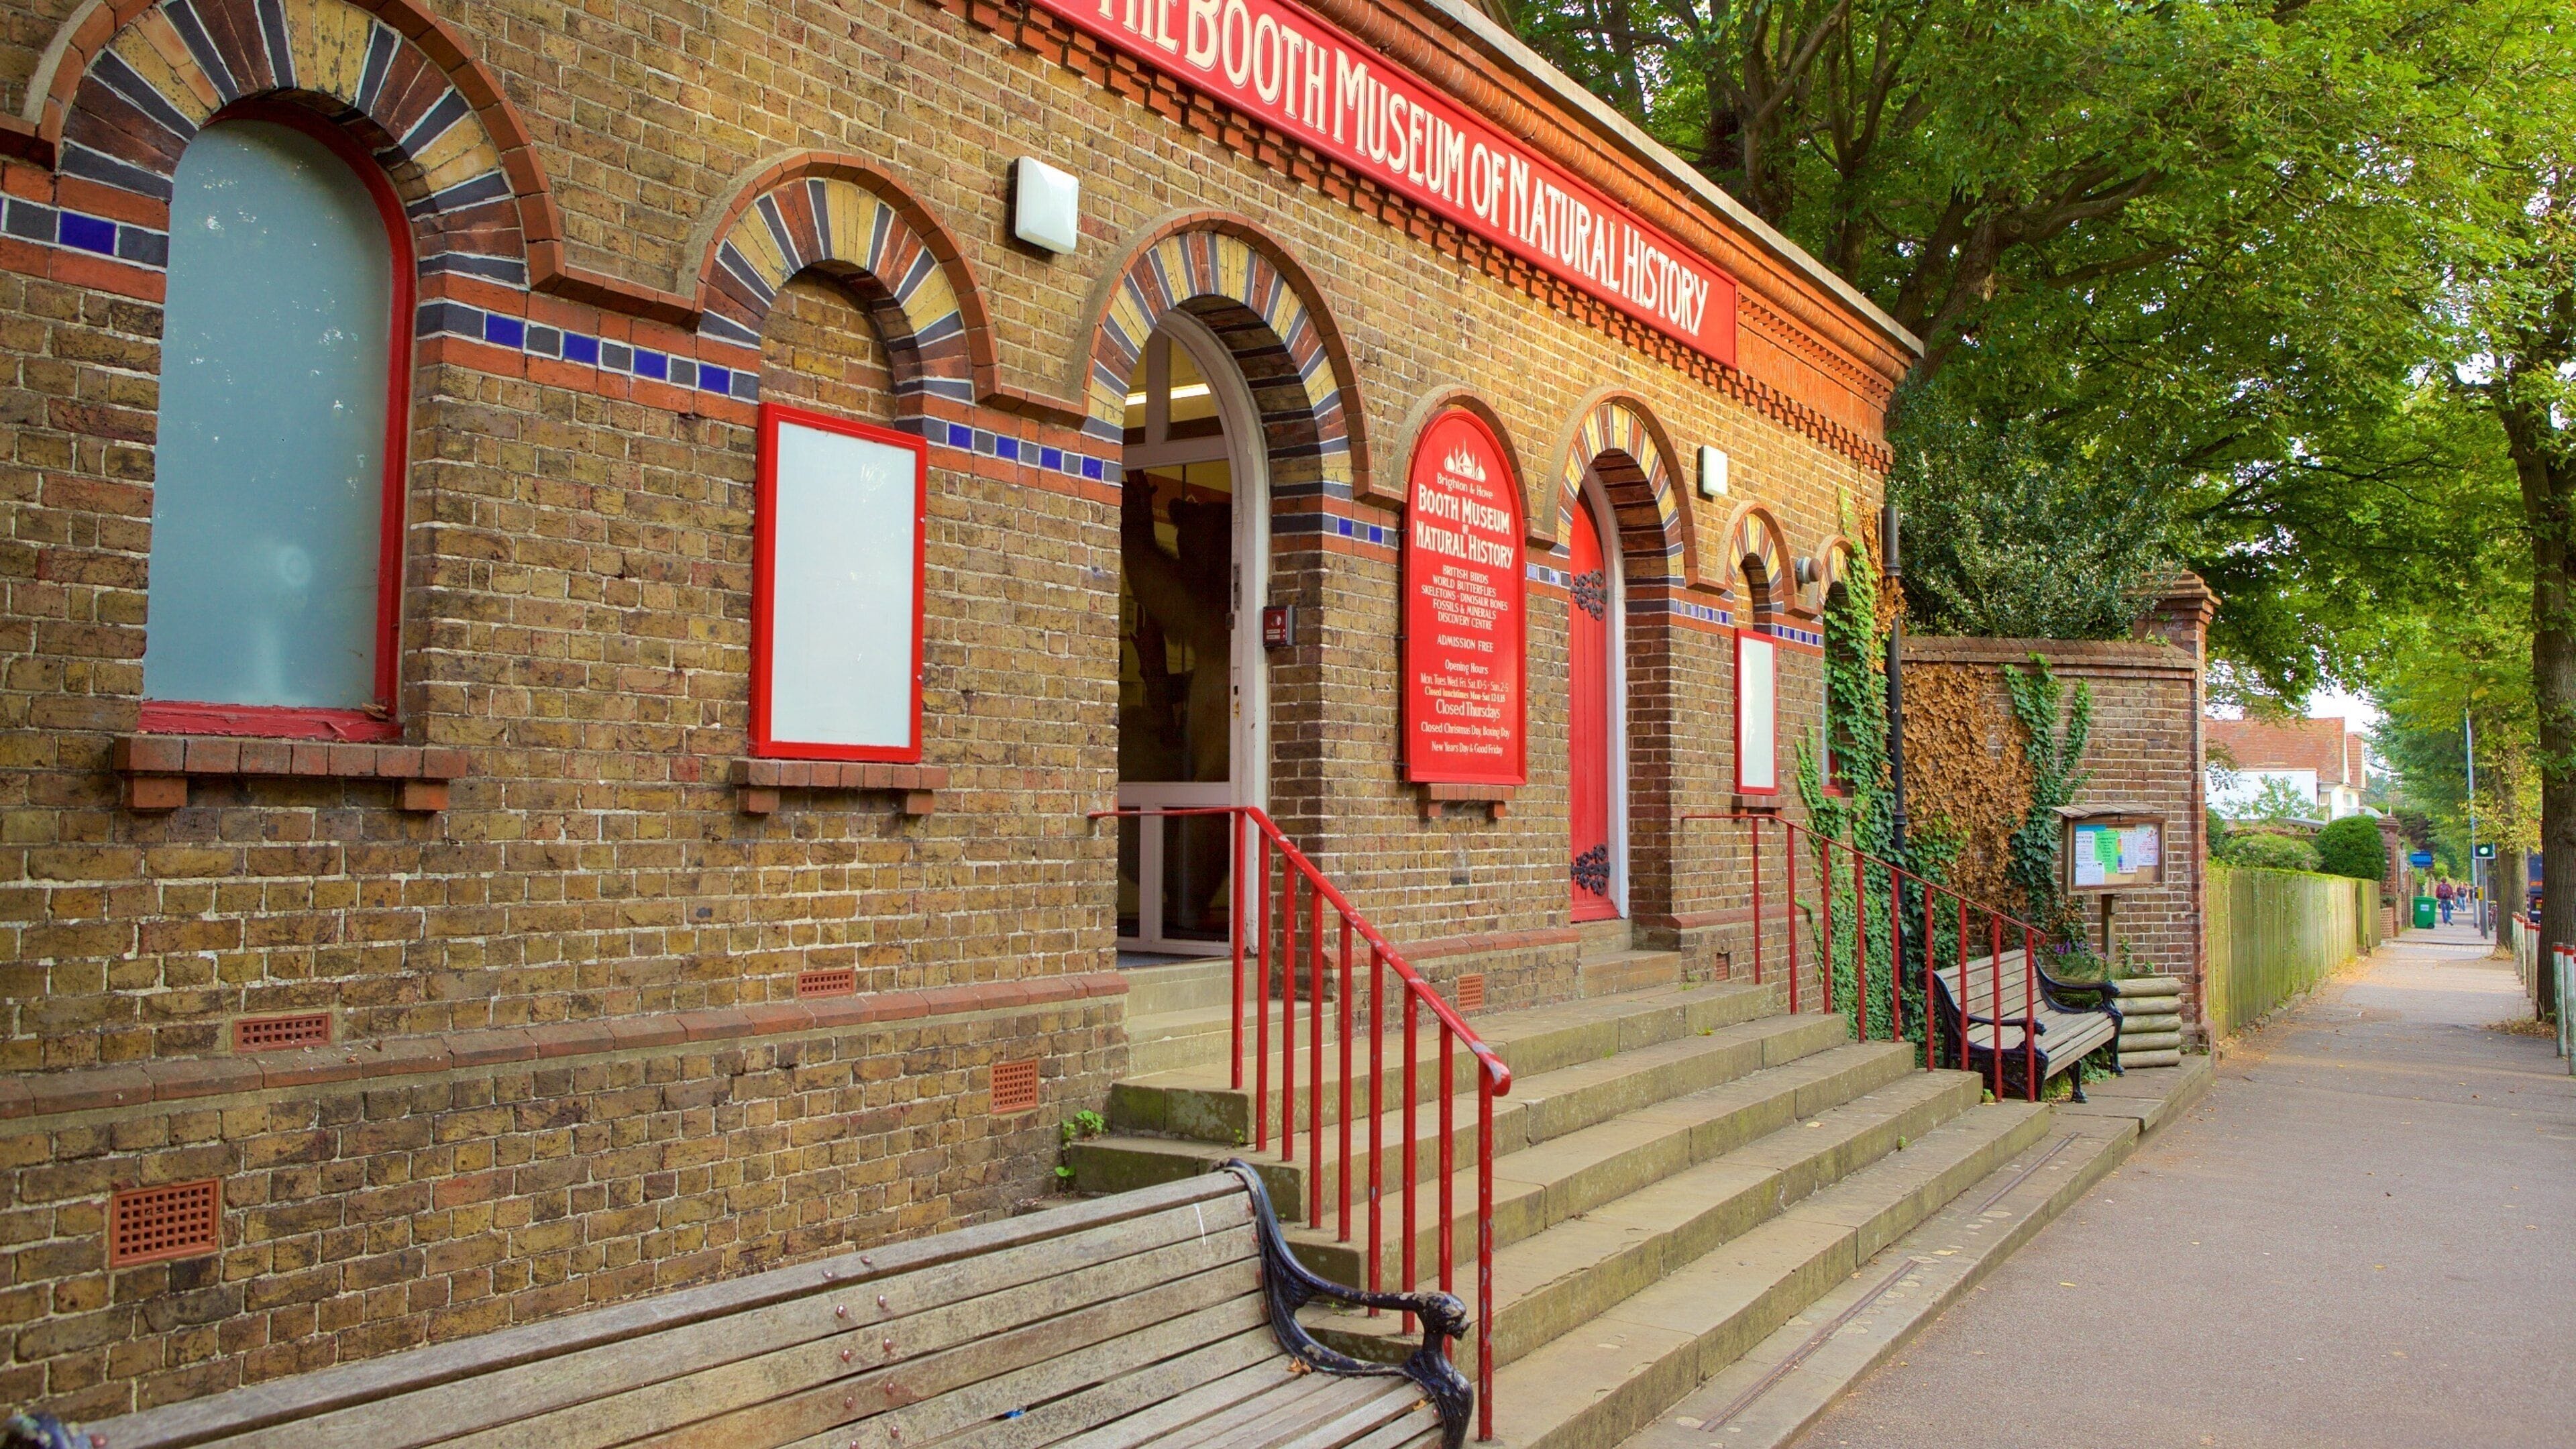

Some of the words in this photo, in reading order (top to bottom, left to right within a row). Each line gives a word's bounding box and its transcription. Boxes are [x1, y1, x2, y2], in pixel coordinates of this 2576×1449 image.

[1185, 0, 1328, 133] BOOTH
[1333, 47, 1466, 209] MUSEUM
[1470, 142, 1507, 227] OF
[1508, 153, 1621, 293] NATURAL
[1622, 223, 1709, 337] HISTORY
[1437, 472, 1468, 492] Brighton
[1470, 483, 1475, 494] &
[1477, 485, 1493, 500] Hove
[1418, 483, 1459, 521] BOOTH
[1462, 497, 1510, 535] MUSEUM
[1462, 524, 1469, 535] OF
[1416, 520, 1467, 559] NATURAL
[1468, 534, 1514, 570] HISTORY
[1443, 564, 1468, 580] BRITISH
[1470, 572, 1489, 584] BIRDS
[1432, 574, 1455, 588] WORLD
[1457, 580, 1496, 597] BUTTERFLIES
[1421, 584, 1456, 600] SKELETONS
[1460, 592, 1489, 607] DINOSAUR
[1490, 599, 1508, 610] BONES
[1433, 598, 1458, 612] FOSSILS
[1460, 605, 1465, 614] &
[1467, 605, 1497, 620] MINERALS
[1438, 611, 1470, 627] DISCOVERY
[1471, 617, 1493, 631] CENTRE
[1437, 634, 1475, 650] ADMISSION
[1478, 640, 1493, 653] FREE
[1445, 659, 1469, 676] Opening
[1470, 662, 1489, 675] Hours
[1425, 686, 1442, 696] Closed
[1436, 698, 1464, 716] Closed
[1465, 701, 1501, 722] Thursdays
[1421, 721, 1442, 733] Closed
[1444, 722, 1470, 735] Christmas
[1483, 725, 1501, 740] Boxing
[1500, 727, 1510, 740] Day
[1432, 741, 1444, 751] New
[1459, 742, 1469, 755] Day
[1474, 743, 1488, 754] Good
[1488, 743, 1503, 757] Friday
